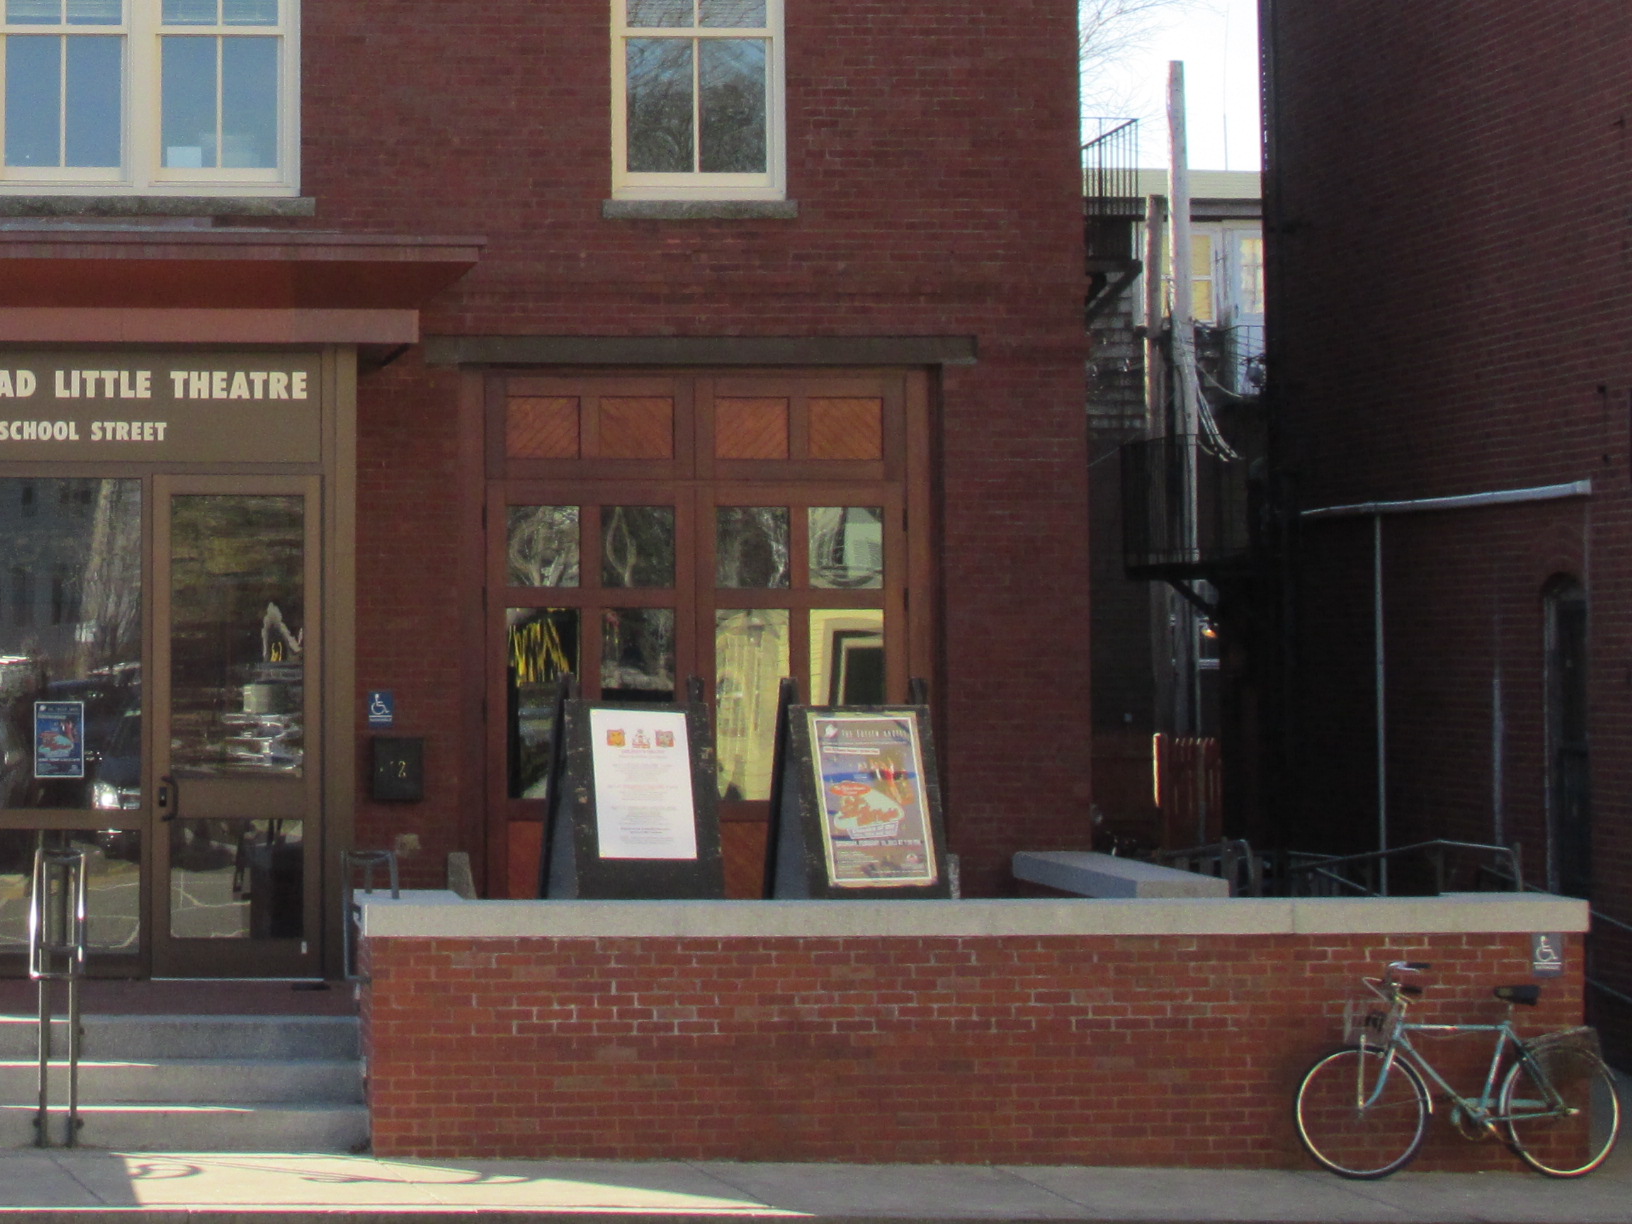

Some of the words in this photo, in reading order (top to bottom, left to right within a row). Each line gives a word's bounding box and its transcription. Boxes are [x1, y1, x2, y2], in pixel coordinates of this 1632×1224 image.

[54, 370, 152, 399] LITTLE
[169, 371, 308, 400] THEATRE
[90, 421, 167, 441] STREET
